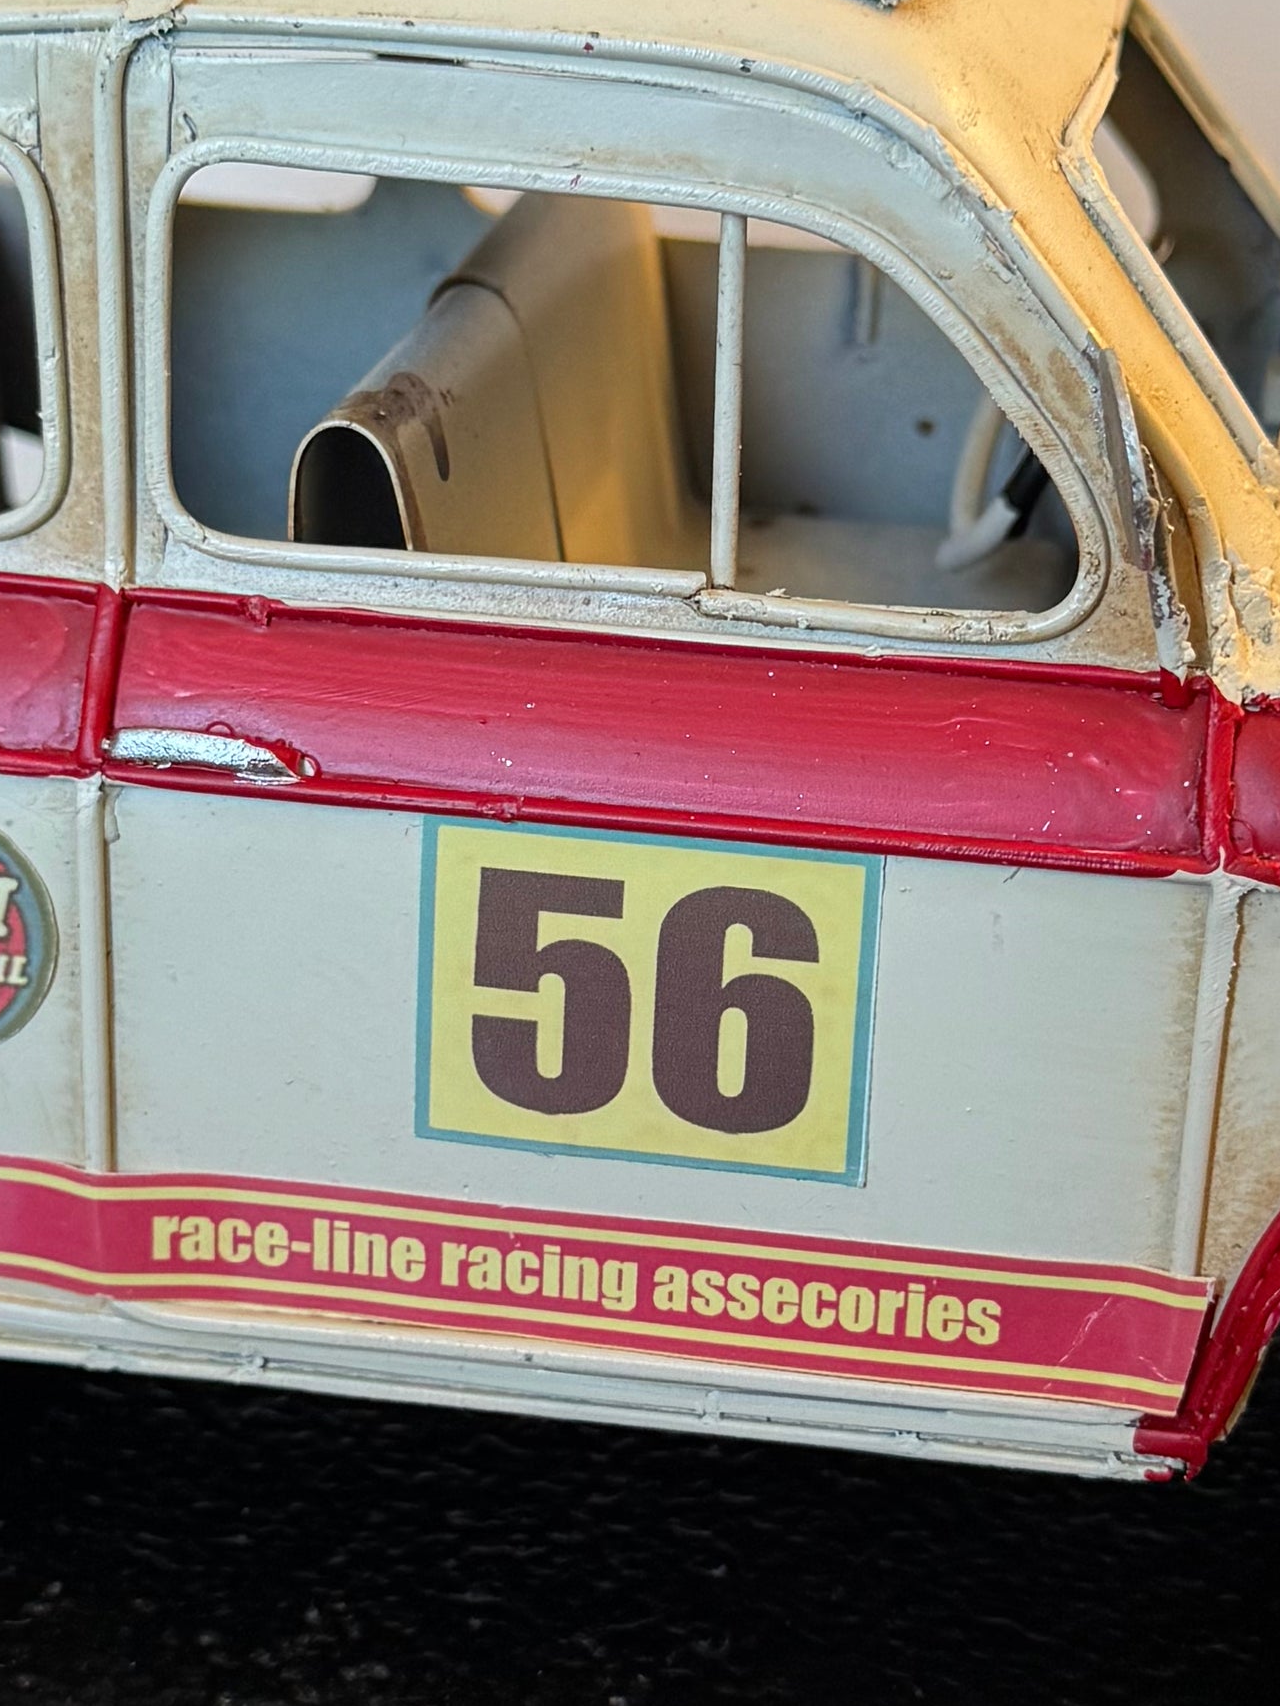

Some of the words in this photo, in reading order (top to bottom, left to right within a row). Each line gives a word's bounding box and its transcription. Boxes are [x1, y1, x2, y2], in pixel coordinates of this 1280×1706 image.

[471, 866, 820, 1134] 56
[151, 1213, 426, 1282] race-line
[440, 1240, 637, 1313] racing
[653, 1262, 1001, 1345] assecories
